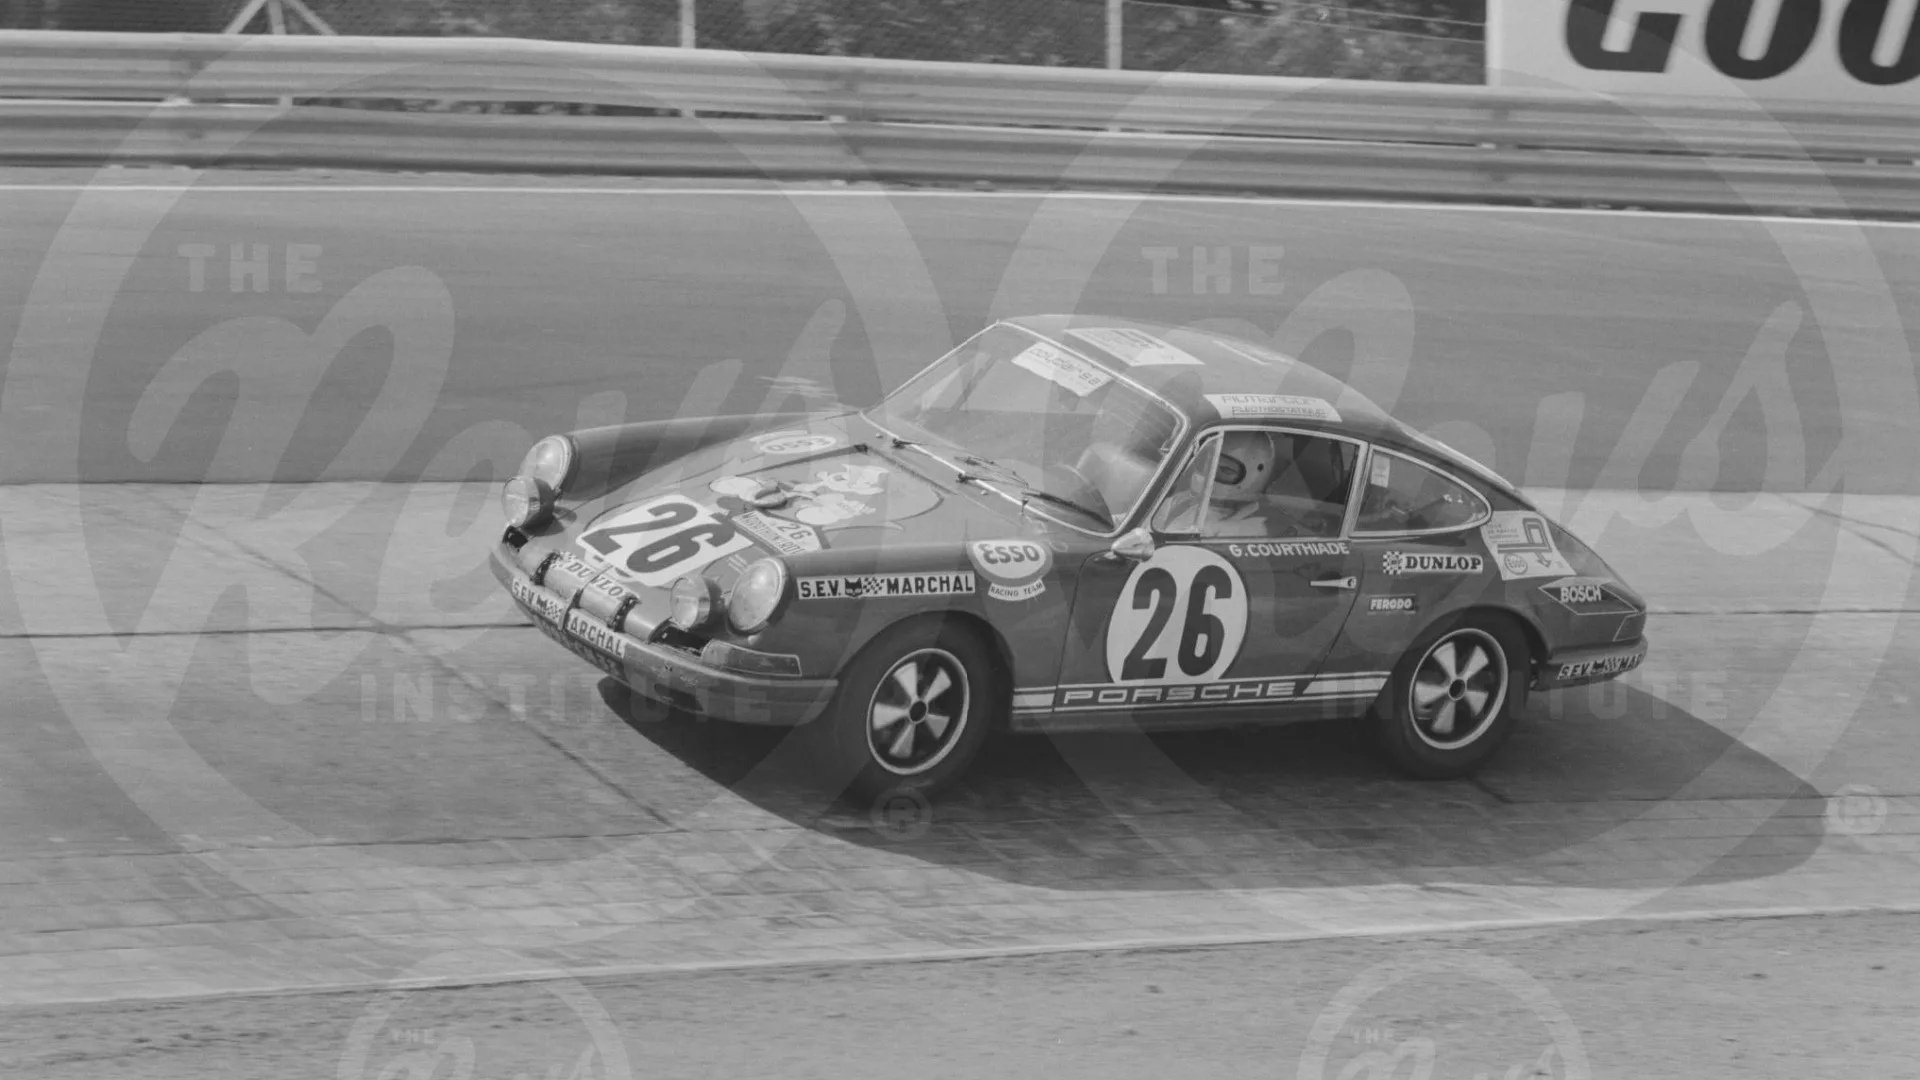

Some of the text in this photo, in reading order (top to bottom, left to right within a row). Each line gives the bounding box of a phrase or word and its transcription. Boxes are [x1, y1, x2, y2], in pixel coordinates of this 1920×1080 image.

[581, 502, 736, 573] 26
[978, 544, 1040, 564] ESSO
[1405, 555, 1482, 571] DUNLOP
[800, 575, 974, 598] S.E.V. MARCHAL
[990, 582, 1043, 597] RACING TEAM
[1560, 586, 1601, 603] BOSCH
[1371, 598, 1412, 610] FERODO
[1120, 565, 1232, 681] 26
[1063, 682, 1296, 705] PORSCHE
